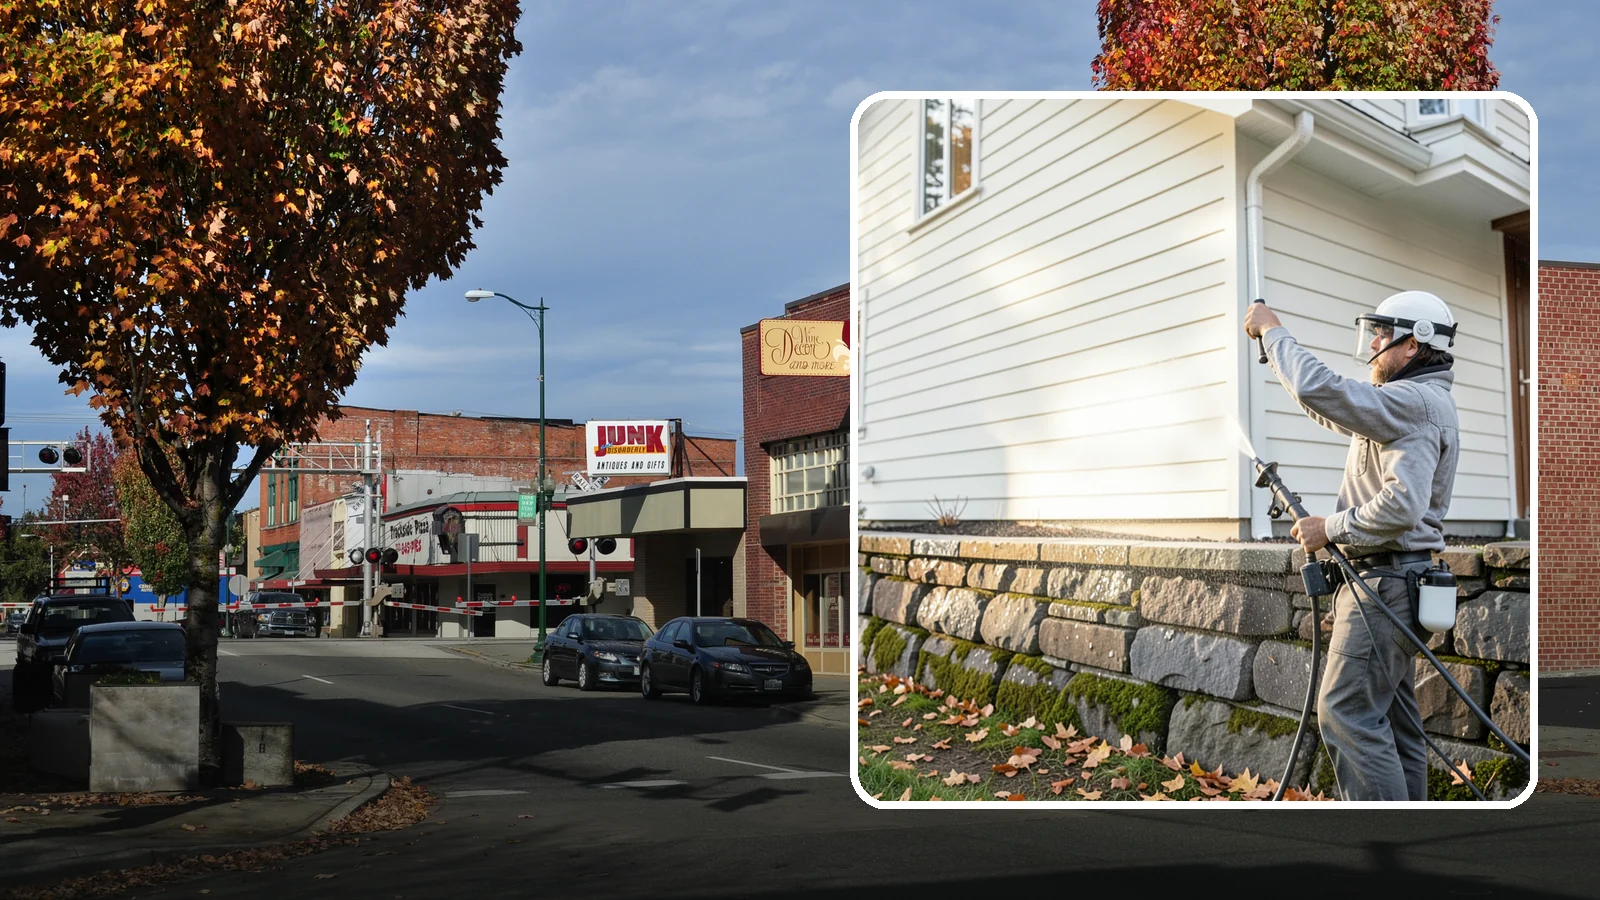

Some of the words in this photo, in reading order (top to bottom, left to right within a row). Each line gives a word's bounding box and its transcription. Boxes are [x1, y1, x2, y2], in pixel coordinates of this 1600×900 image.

[765, 327, 831, 366] Decor
[595, 425, 665, 457] JUNK
[607, 446, 646, 454] DISORDERLY
[597, 461, 628, 470] ANTIQUES
[631, 461, 644, 470] AND
[647, 460, 665, 469] GIFTS
[414, 519, 429, 535] Pizza
